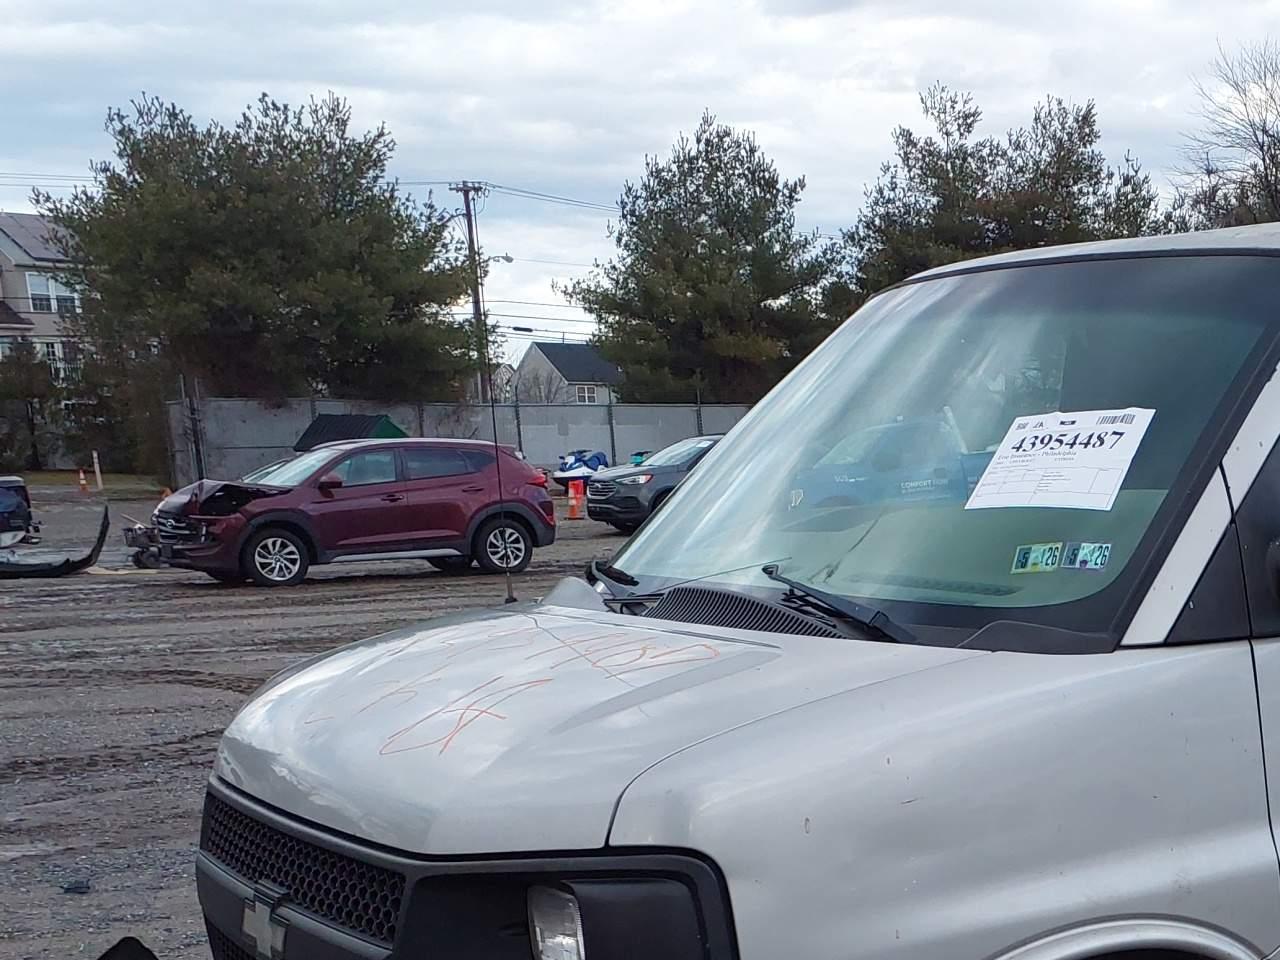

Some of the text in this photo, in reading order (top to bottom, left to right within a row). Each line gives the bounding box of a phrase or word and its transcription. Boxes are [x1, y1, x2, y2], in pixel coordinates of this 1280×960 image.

[1011, 430, 1126, 452] 43954487
[1045, 546, 1060, 567] 26
[1095, 545, 1110, 566] 26
